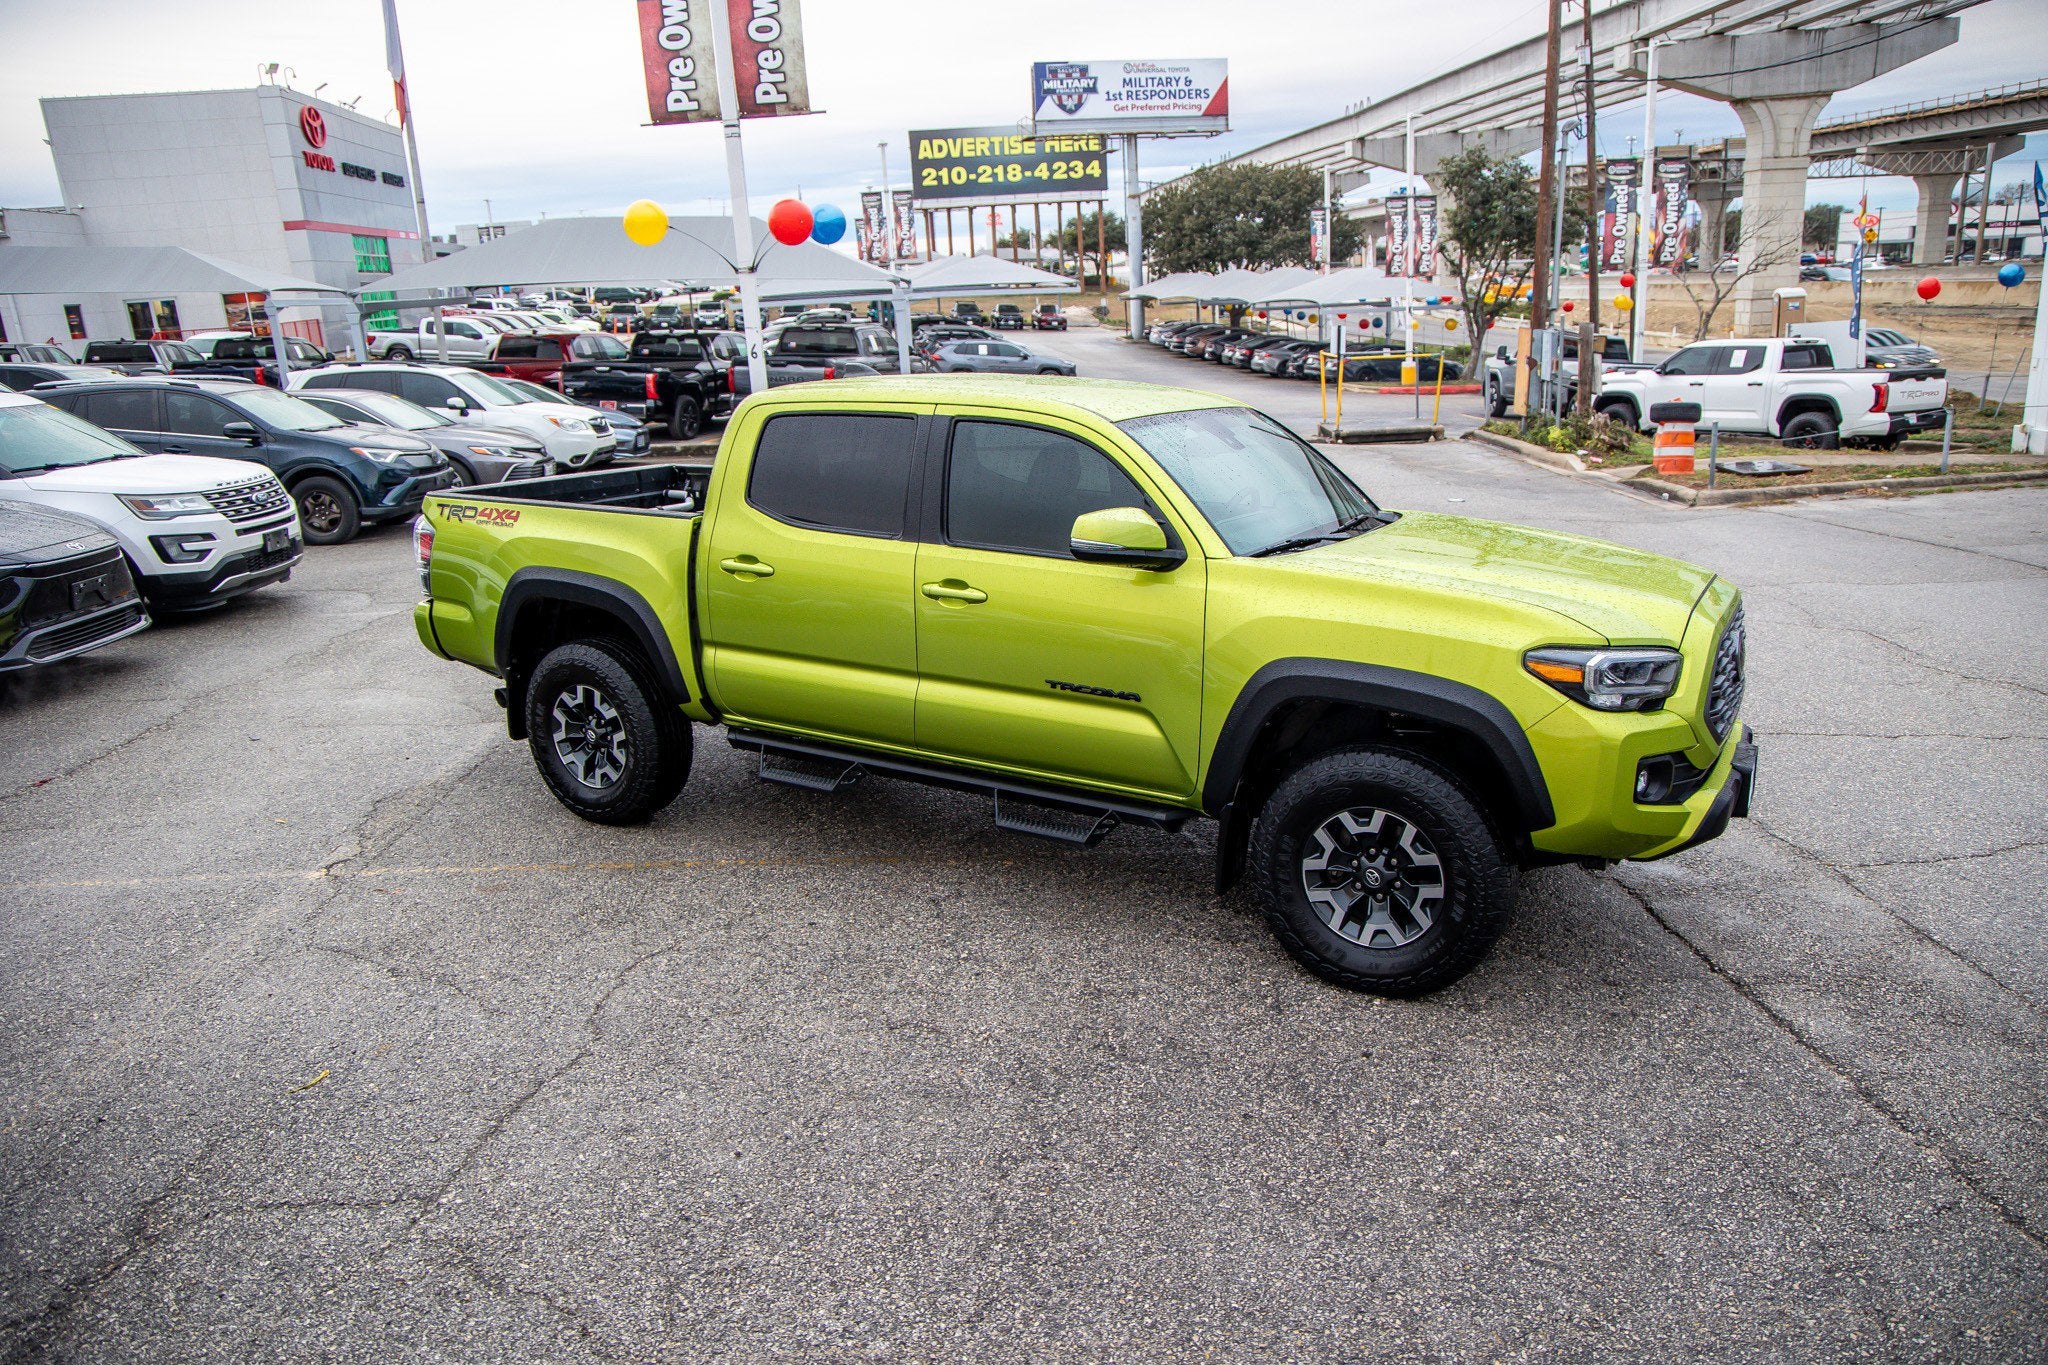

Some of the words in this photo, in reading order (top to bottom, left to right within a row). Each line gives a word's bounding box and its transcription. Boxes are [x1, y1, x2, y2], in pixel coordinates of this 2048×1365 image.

[667, 57, 699, 112] Pre
[755, 50, 788, 104] Pre
[1043, 79, 1096, 90] MILITARY
[1122, 76, 1182, 88] MILITARY
[1184, 76, 1193, 87] &
[1105, 91, 1123, 101] 1st
[1126, 88, 1211, 101] RESPONDERS
[1113, 103, 1129, 112] Get
[1131, 102, 1171, 112] Preferred
[1173, 102, 1202, 112] Pricing
[918, 135, 1036, 160] ADVERTISE
[1044, 135, 1102, 153] HERE
[301, 150, 336, 173] TOYOTA
[922, 161, 1101, 186] 210-218-4234
[1612, 185, 1628, 236] Owned
[1663, 183, 1679, 234] Owned
[1391, 215, 1403, 254] Owned
[1419, 214, 1431, 253] Owned
[901, 240, 914, 257] Pre
[1610, 240, 1625, 263] Pre
[1660, 238, 1676, 261] Pre
[1390, 254, 1403, 274] Pre
[1419, 253, 1431, 273] Pre
[750, 344, 758, 359] 6
[1900, 390, 1922, 400] TRD
[437, 503, 478, 523] TRD
[1044, 679, 1142, 702] TACOMA
